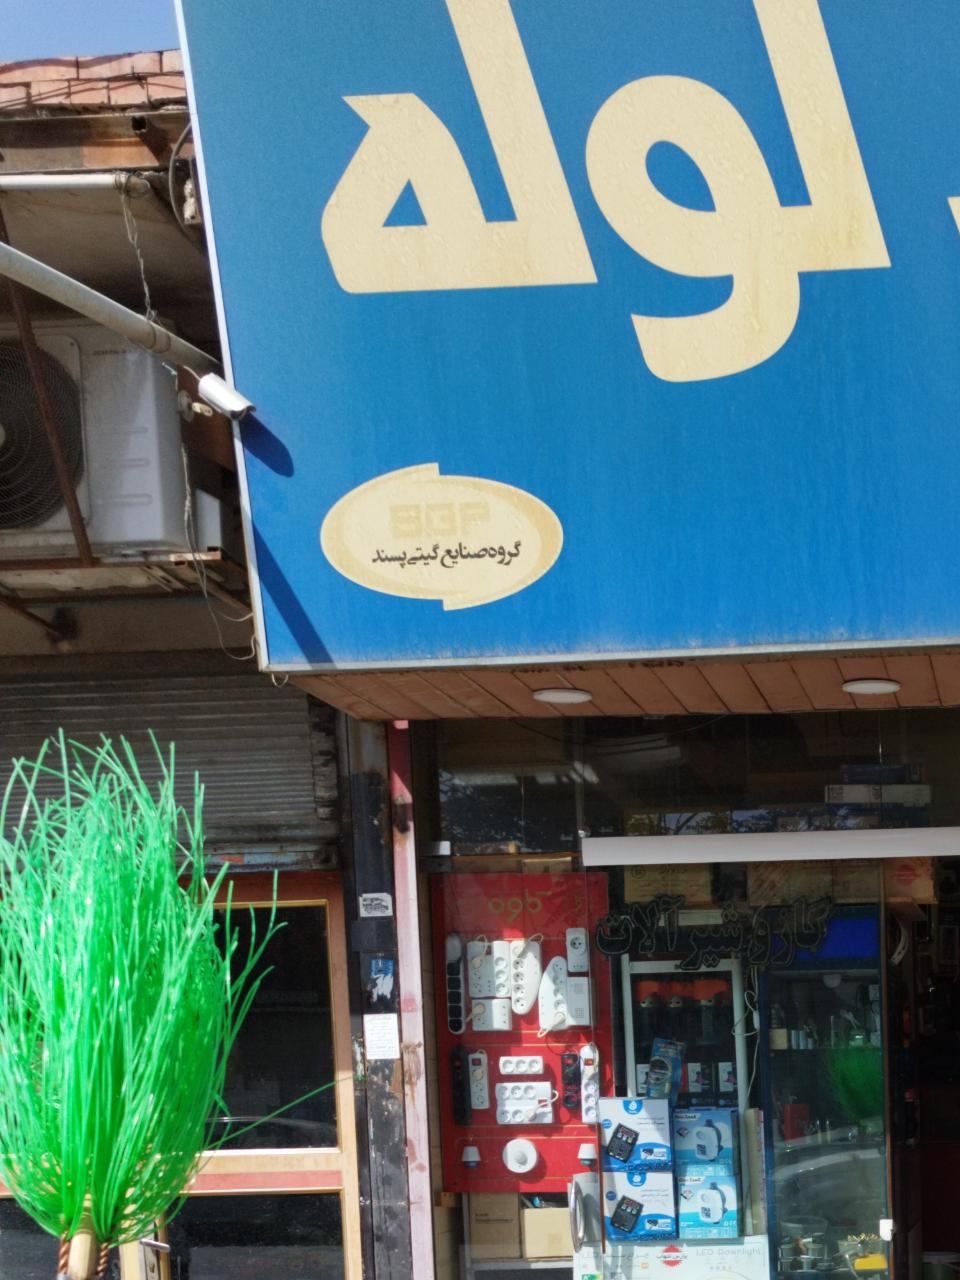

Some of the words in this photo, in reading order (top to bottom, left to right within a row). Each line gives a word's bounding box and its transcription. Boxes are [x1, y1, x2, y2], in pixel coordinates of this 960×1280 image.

[321, 0, 891, 382] لوله
[439, 542, 487, 568] صنایع
[488, 540, 522, 566] گروه
[696, 1247, 714, 1256] LED
